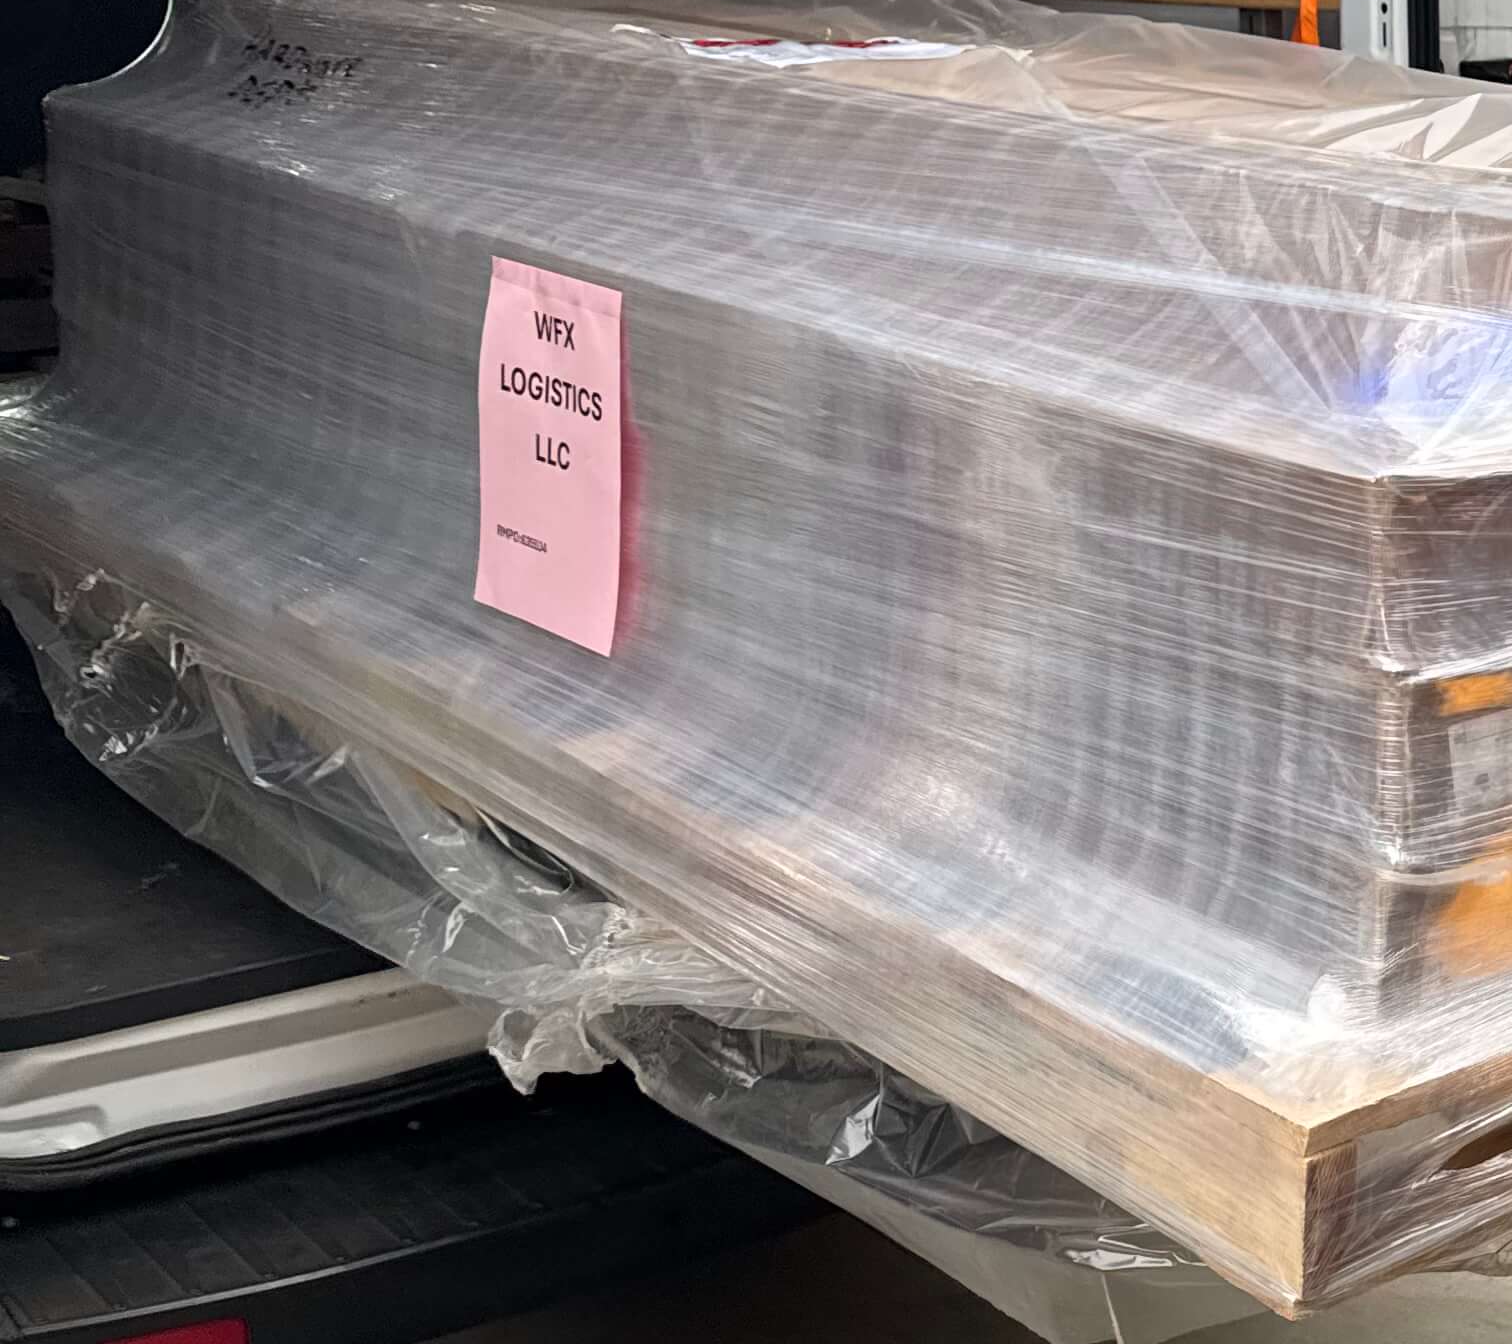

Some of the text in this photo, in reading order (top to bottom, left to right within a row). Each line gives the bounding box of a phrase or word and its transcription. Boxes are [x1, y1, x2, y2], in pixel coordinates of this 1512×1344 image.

[534, 311, 575, 351] WFX
[500, 363, 603, 421] LOGISTICS
[535, 434, 571, 470] LLC
